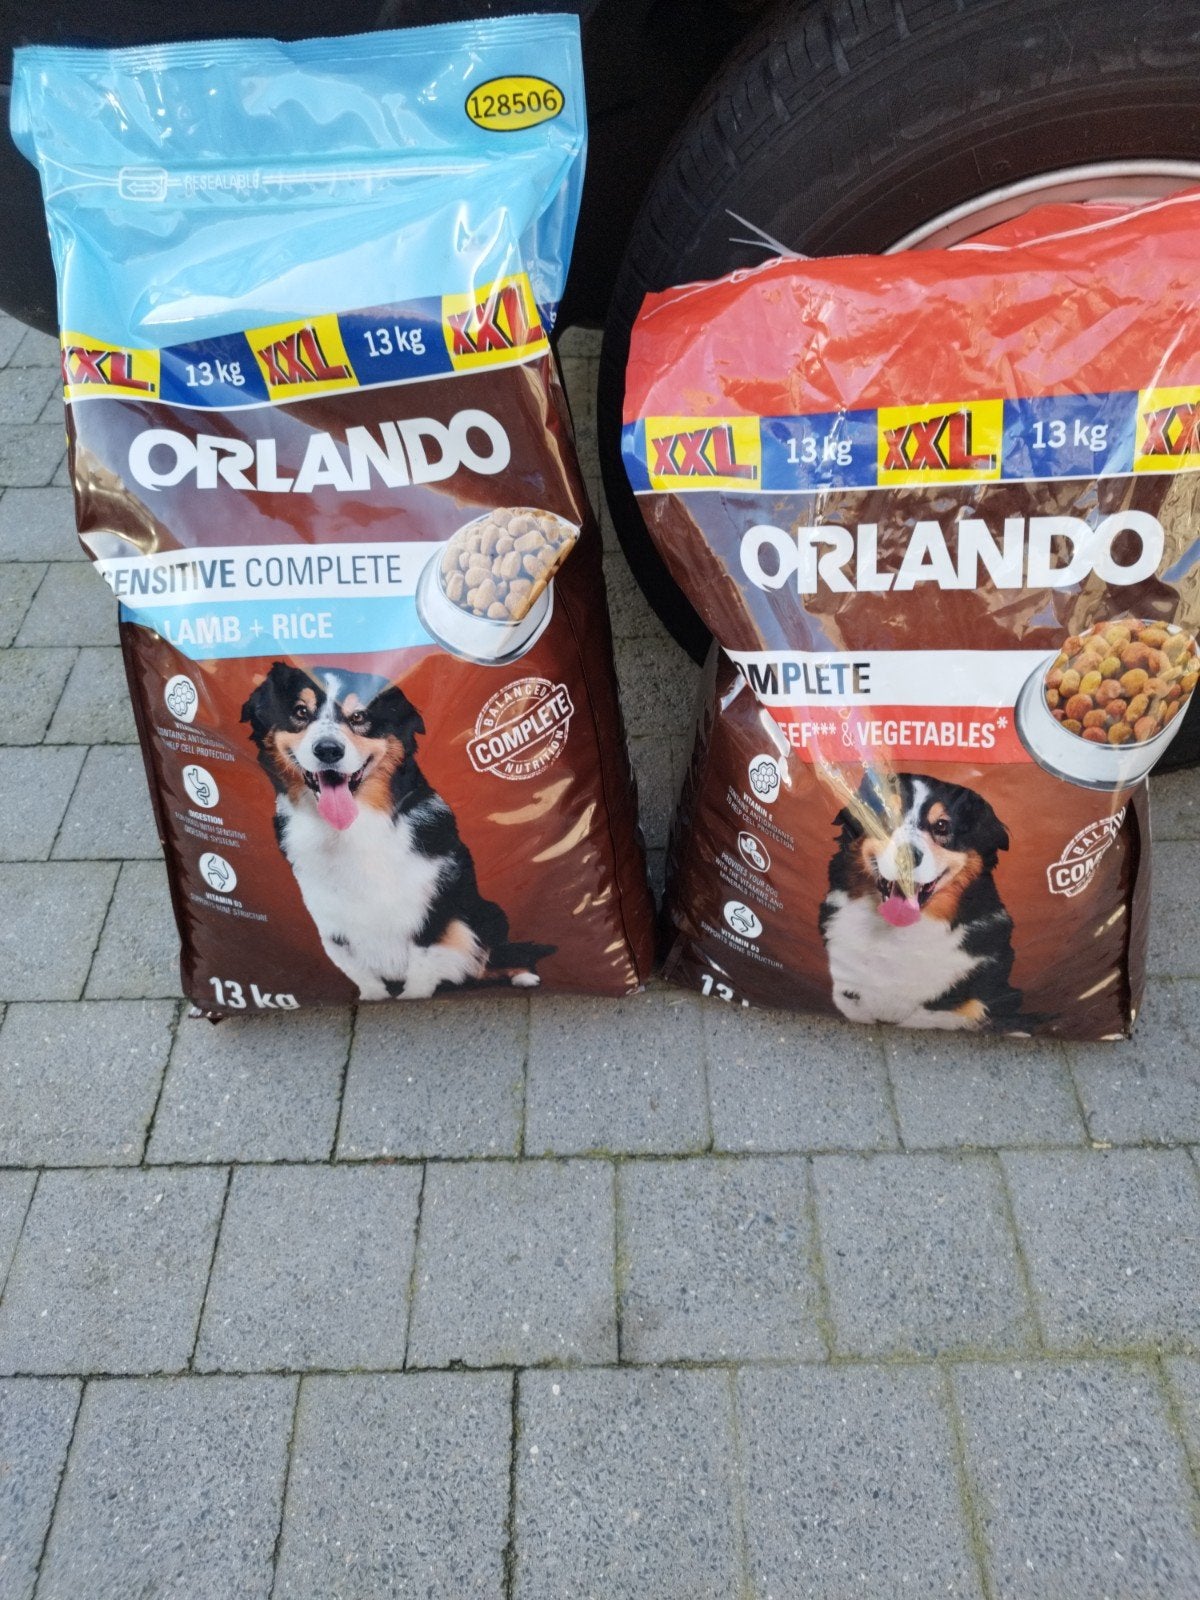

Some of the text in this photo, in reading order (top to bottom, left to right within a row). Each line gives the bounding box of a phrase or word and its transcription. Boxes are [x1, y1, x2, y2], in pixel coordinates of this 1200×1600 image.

[470, 89, 558, 119] 128506
[185, 364, 215, 387] 13
[217, 360, 245, 386] kg
[257, 325, 353, 386] XXL
[363, 328, 393, 358] 13
[394, 325, 426, 356] kg
[447, 281, 546, 355] XXL
[128, 409, 511, 493] ORLANDO
[651, 424, 758, 480] XXL
[787, 437, 817, 463] 13
[823, 435, 853, 465] kg
[883, 411, 996, 470] XXL
[1032, 421, 1067, 449] 13
[1073, 418, 1109, 452] kg
[740, 510, 1165, 594] ORLANDO
[245, 554, 402, 587] COMPLETE
[163, 616, 241, 646] LAMB
[272, 612, 334, 641] RICE
[484, 684, 547, 727] BALANCED
[475, 692, 570, 764] COMPLETE
[841, 722, 855, 747] &
[505, 730, 564, 774] NUTRITION
[743, 791, 768, 817] VITAMIN
[757, 823, 795, 851] PROTECTION
[721, 852, 748, 877] PROVIDES
[205, 892, 233, 906] VITAMIN
[721, 928, 761, 954] VITAMIN D3
[209, 976, 247, 1009] 13
